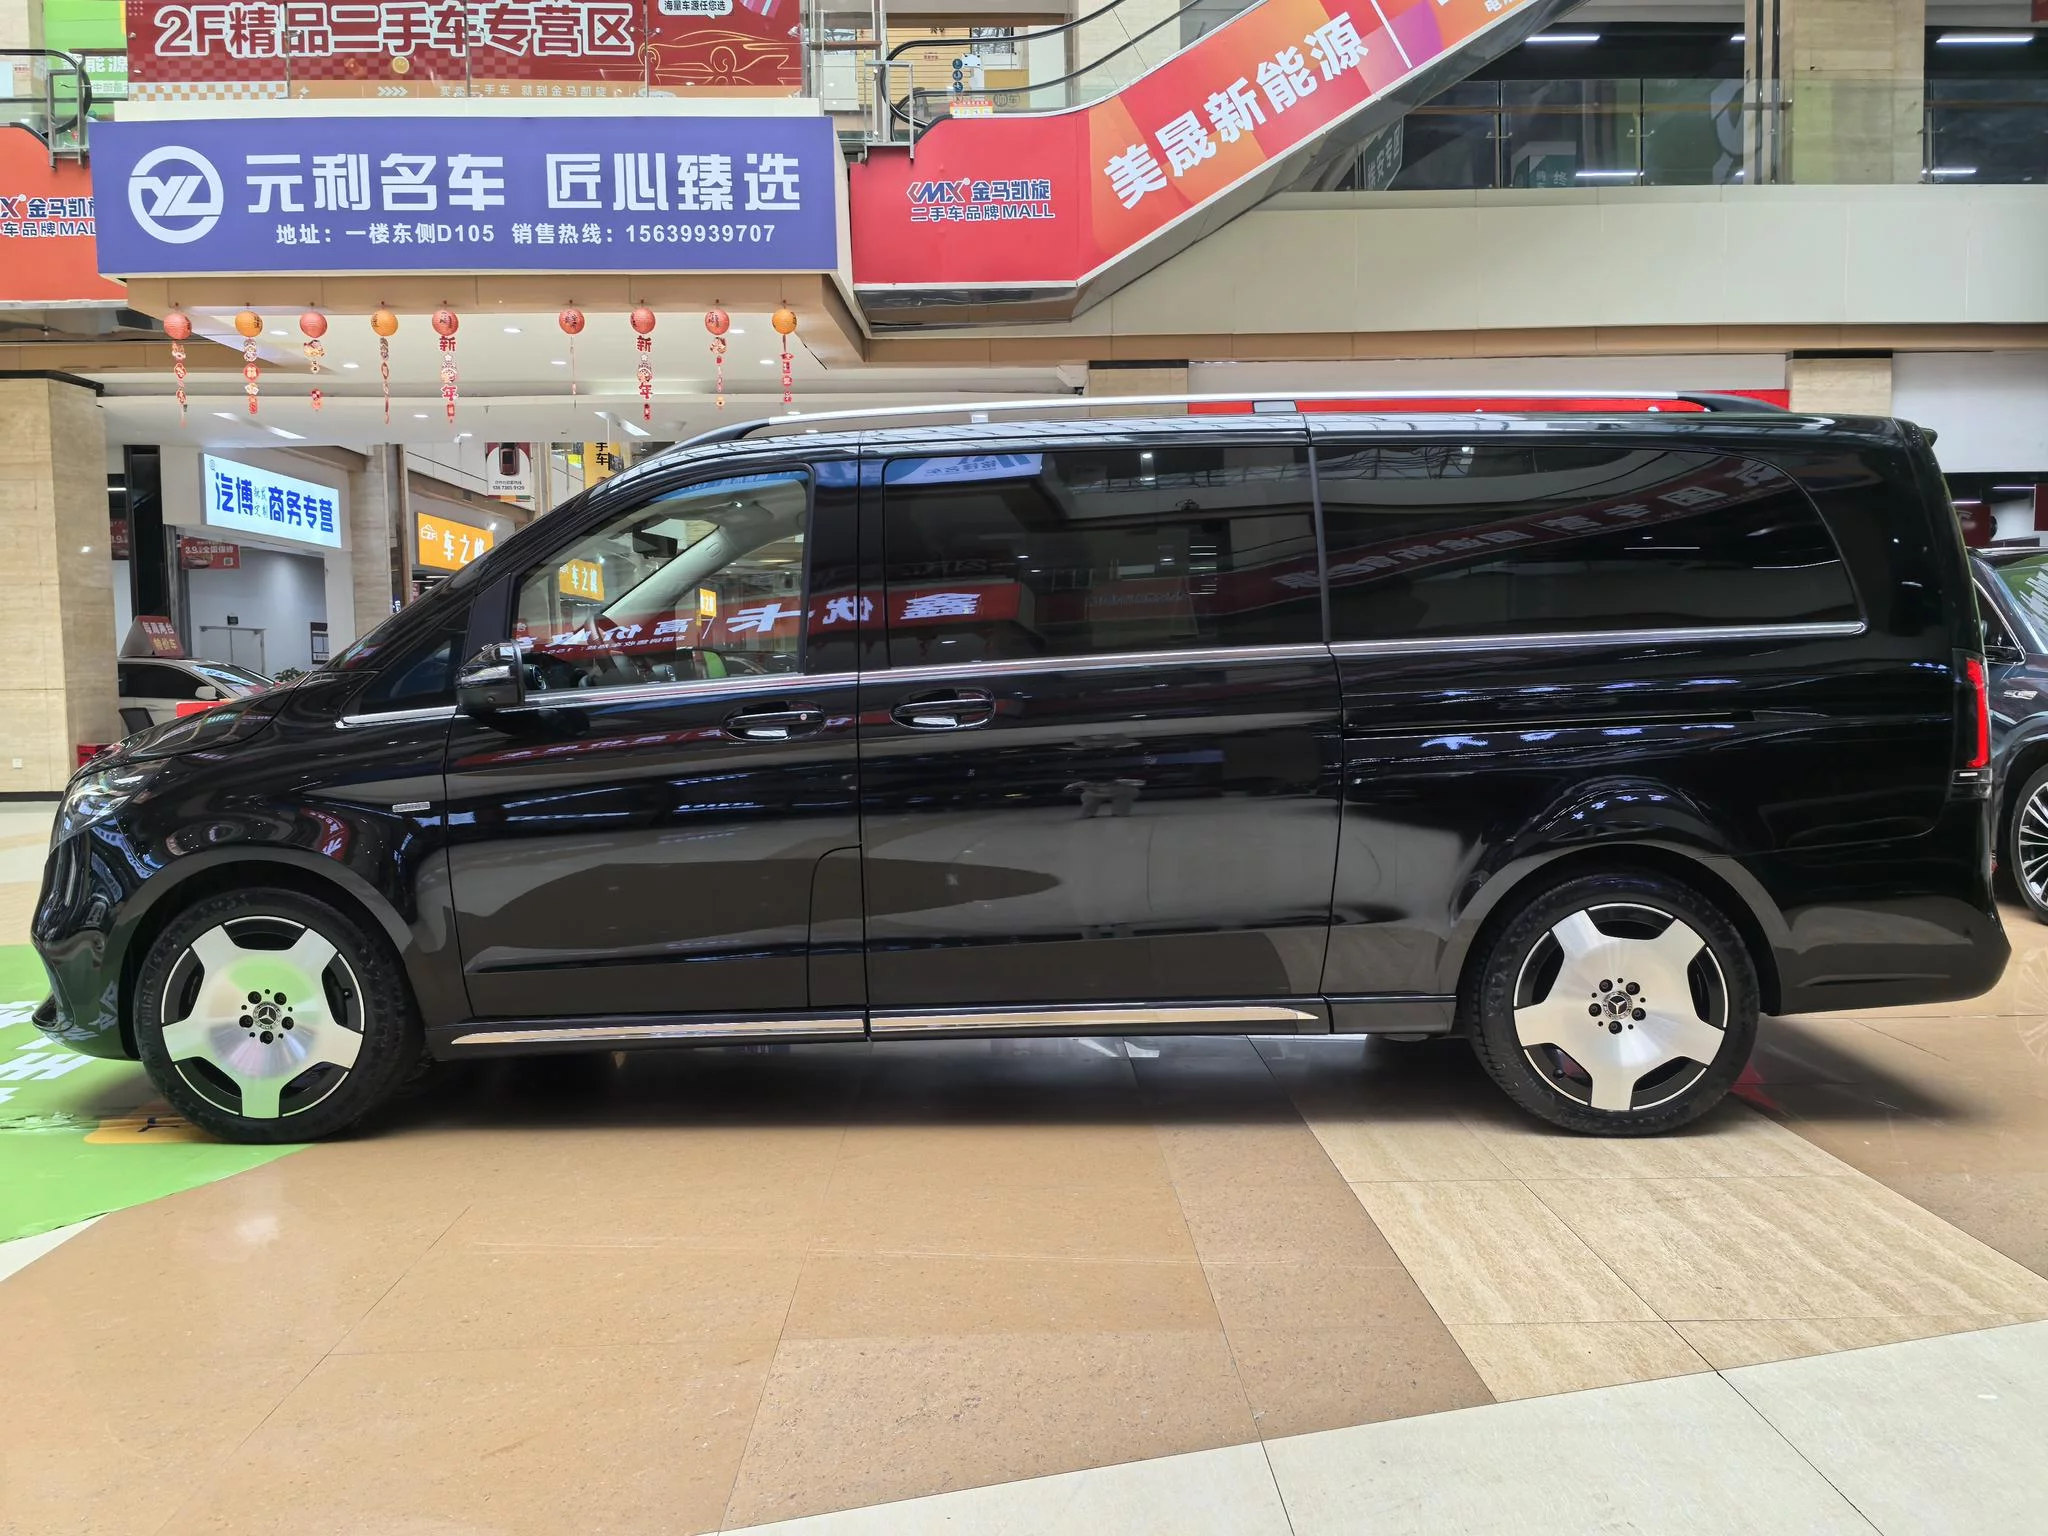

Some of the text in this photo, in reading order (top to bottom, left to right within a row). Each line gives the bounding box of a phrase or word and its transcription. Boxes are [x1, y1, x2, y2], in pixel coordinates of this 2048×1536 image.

[154, 1, 634, 58] 2F精品二手车专营区
[1103, 12, 1368, 209] 美晟新能源
[246, 153, 800, 214] 元利名车 匠心臻选
[971, 178, 1052, 202] 金马凯旋
[268, 486, 334, 533] 商务专营
